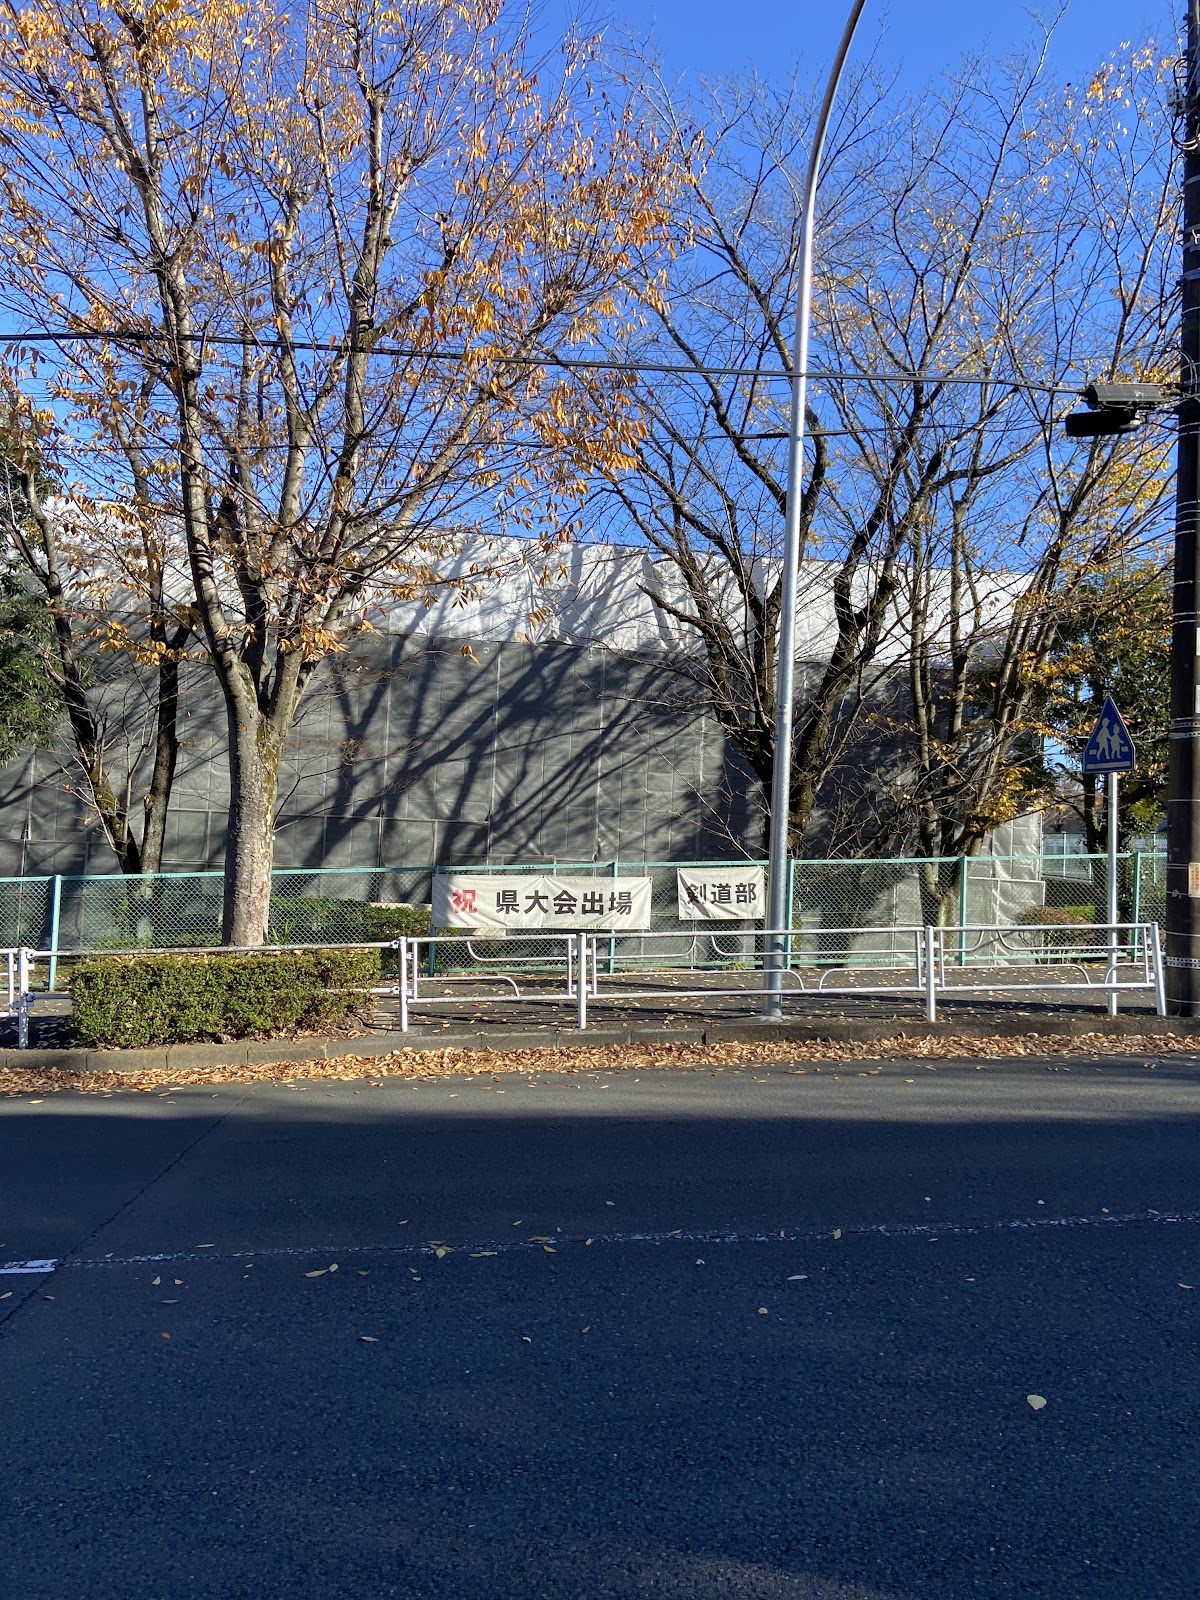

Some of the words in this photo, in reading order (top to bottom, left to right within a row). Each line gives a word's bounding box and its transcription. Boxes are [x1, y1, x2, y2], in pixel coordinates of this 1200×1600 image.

[452, 889, 478, 914] 祝
[495, 889, 633, 916] 県大会出場
[686, 882, 757, 905] 剣道部
